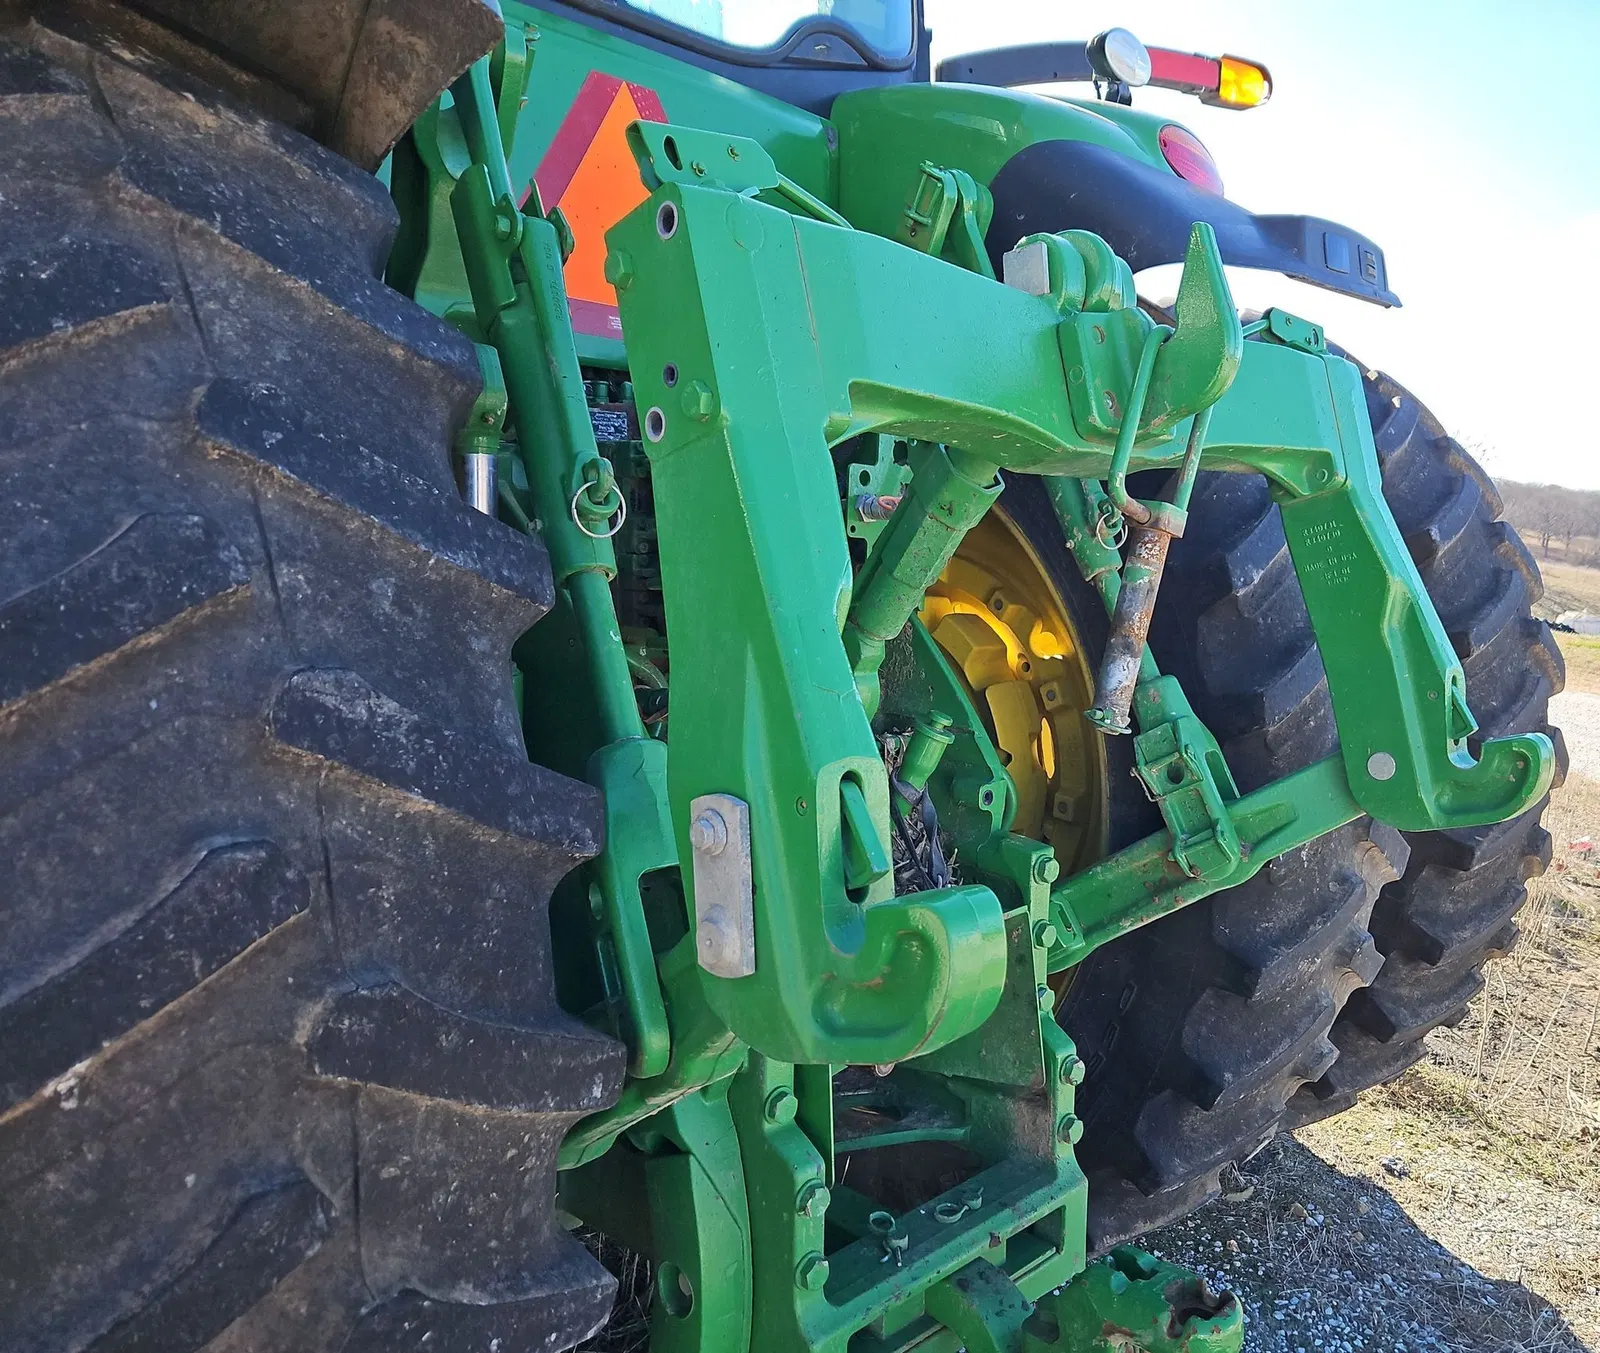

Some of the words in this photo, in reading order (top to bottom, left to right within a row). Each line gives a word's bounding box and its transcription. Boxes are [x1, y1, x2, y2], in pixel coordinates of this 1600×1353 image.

[1303, 561, 1324, 573] MADE
[1327, 557, 1338, 566] IN
[1341, 552, 1358, 562] USA
